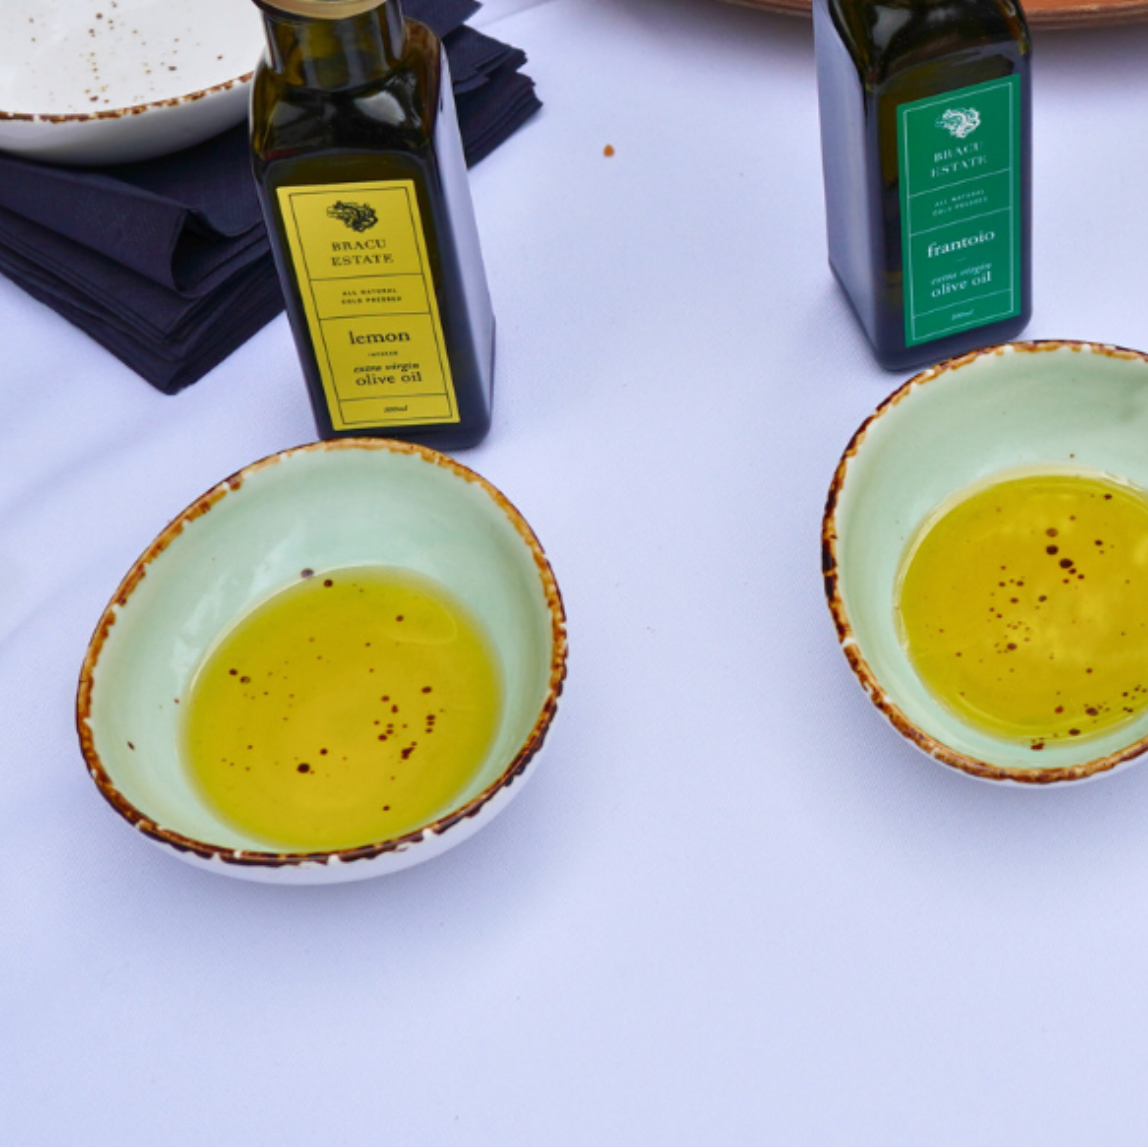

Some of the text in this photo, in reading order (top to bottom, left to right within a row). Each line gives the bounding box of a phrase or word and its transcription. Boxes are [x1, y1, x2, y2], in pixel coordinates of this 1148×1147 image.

[934, 141, 984, 163] BRACU
[931, 155, 988, 178] ESTATE
[331, 239, 387, 252] BRACU
[927, 230, 996, 258] frantoio
[331, 254, 394, 267] ESTATE
[931, 271, 992, 298] olive oil
[348, 330, 411, 345] lemon
[353, 361, 420, 374] extra virgin
[355, 371, 423, 386] olive oil
